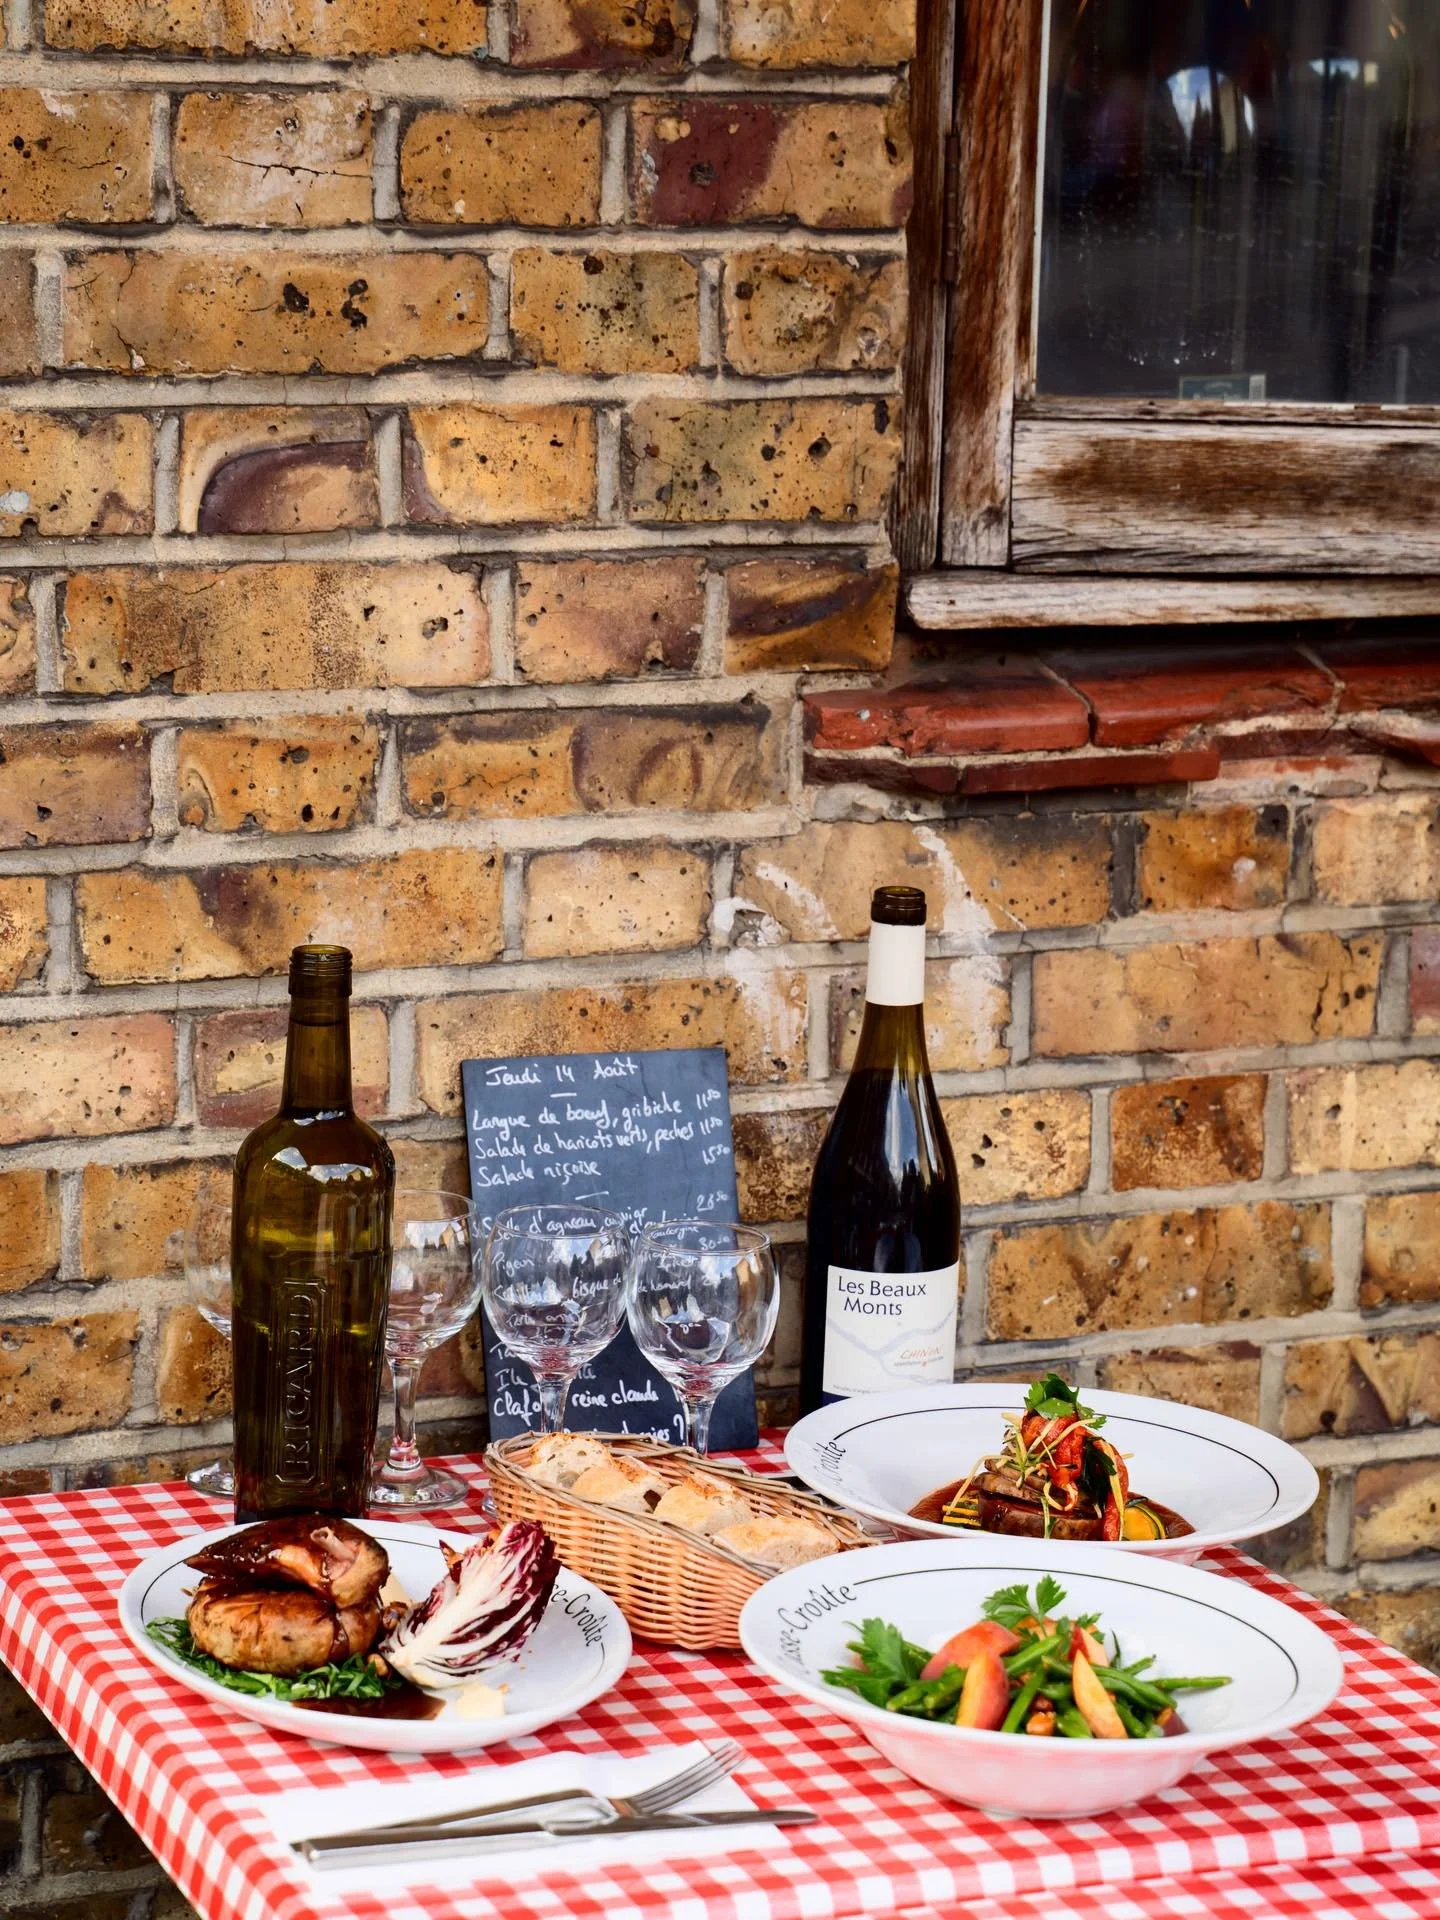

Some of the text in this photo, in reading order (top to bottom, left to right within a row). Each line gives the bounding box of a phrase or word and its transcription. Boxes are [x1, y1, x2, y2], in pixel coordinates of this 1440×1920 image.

[485, 1056, 638, 1086] Jeudi 14 Août
[538, 1106, 560, 1125] de
[533, 1134, 554, 1154] de
[554, 1131, 613, 1150] haricots
[838, 1275, 927, 1297] Les Beaux
[843, 1297, 902, 1316] Monts
[284, 1294, 313, 1464] RICARD
[571, 1390, 608, 1408] reine
